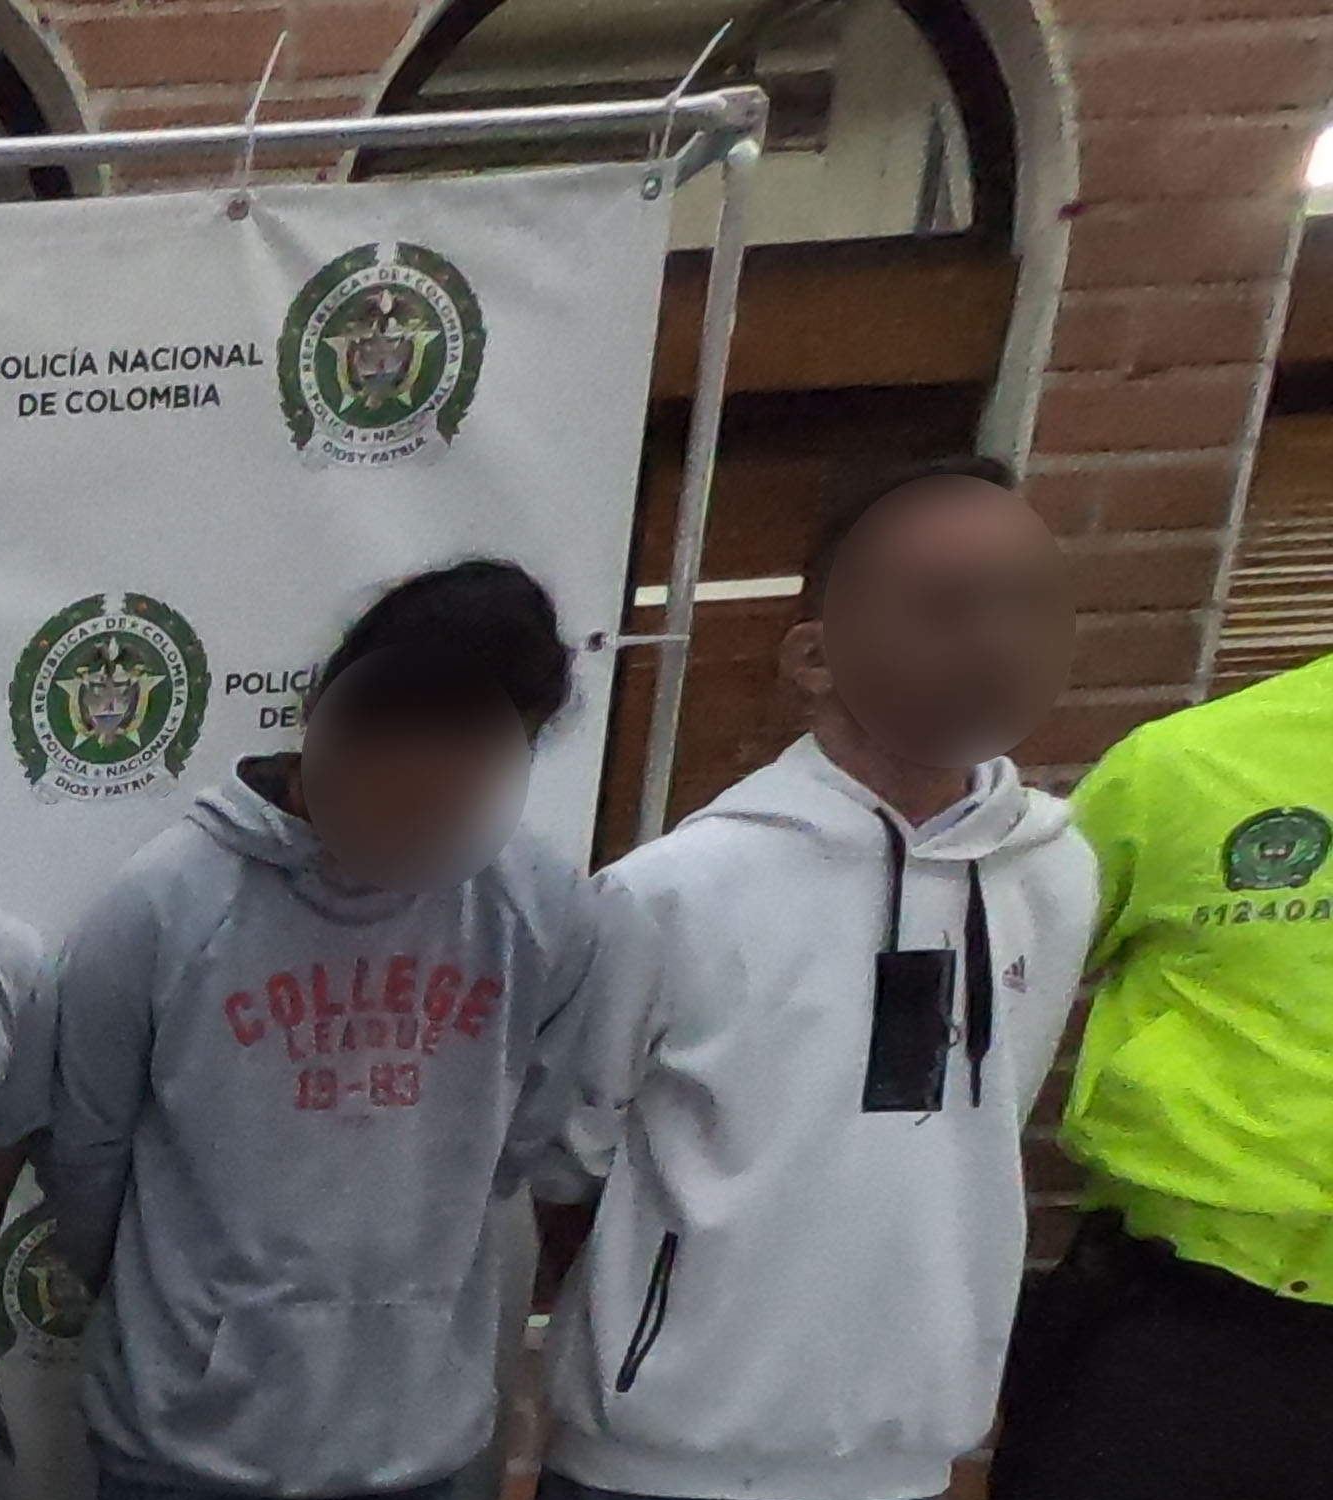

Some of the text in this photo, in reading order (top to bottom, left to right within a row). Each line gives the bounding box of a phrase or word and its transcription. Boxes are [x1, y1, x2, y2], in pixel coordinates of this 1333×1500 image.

[108, 343, 263, 375] NACIONAL
[18, 384, 220, 417] DE COLOMBIA
[260, 706, 297, 728] DE
[224, 953, 504, 1046] COLLEGE
